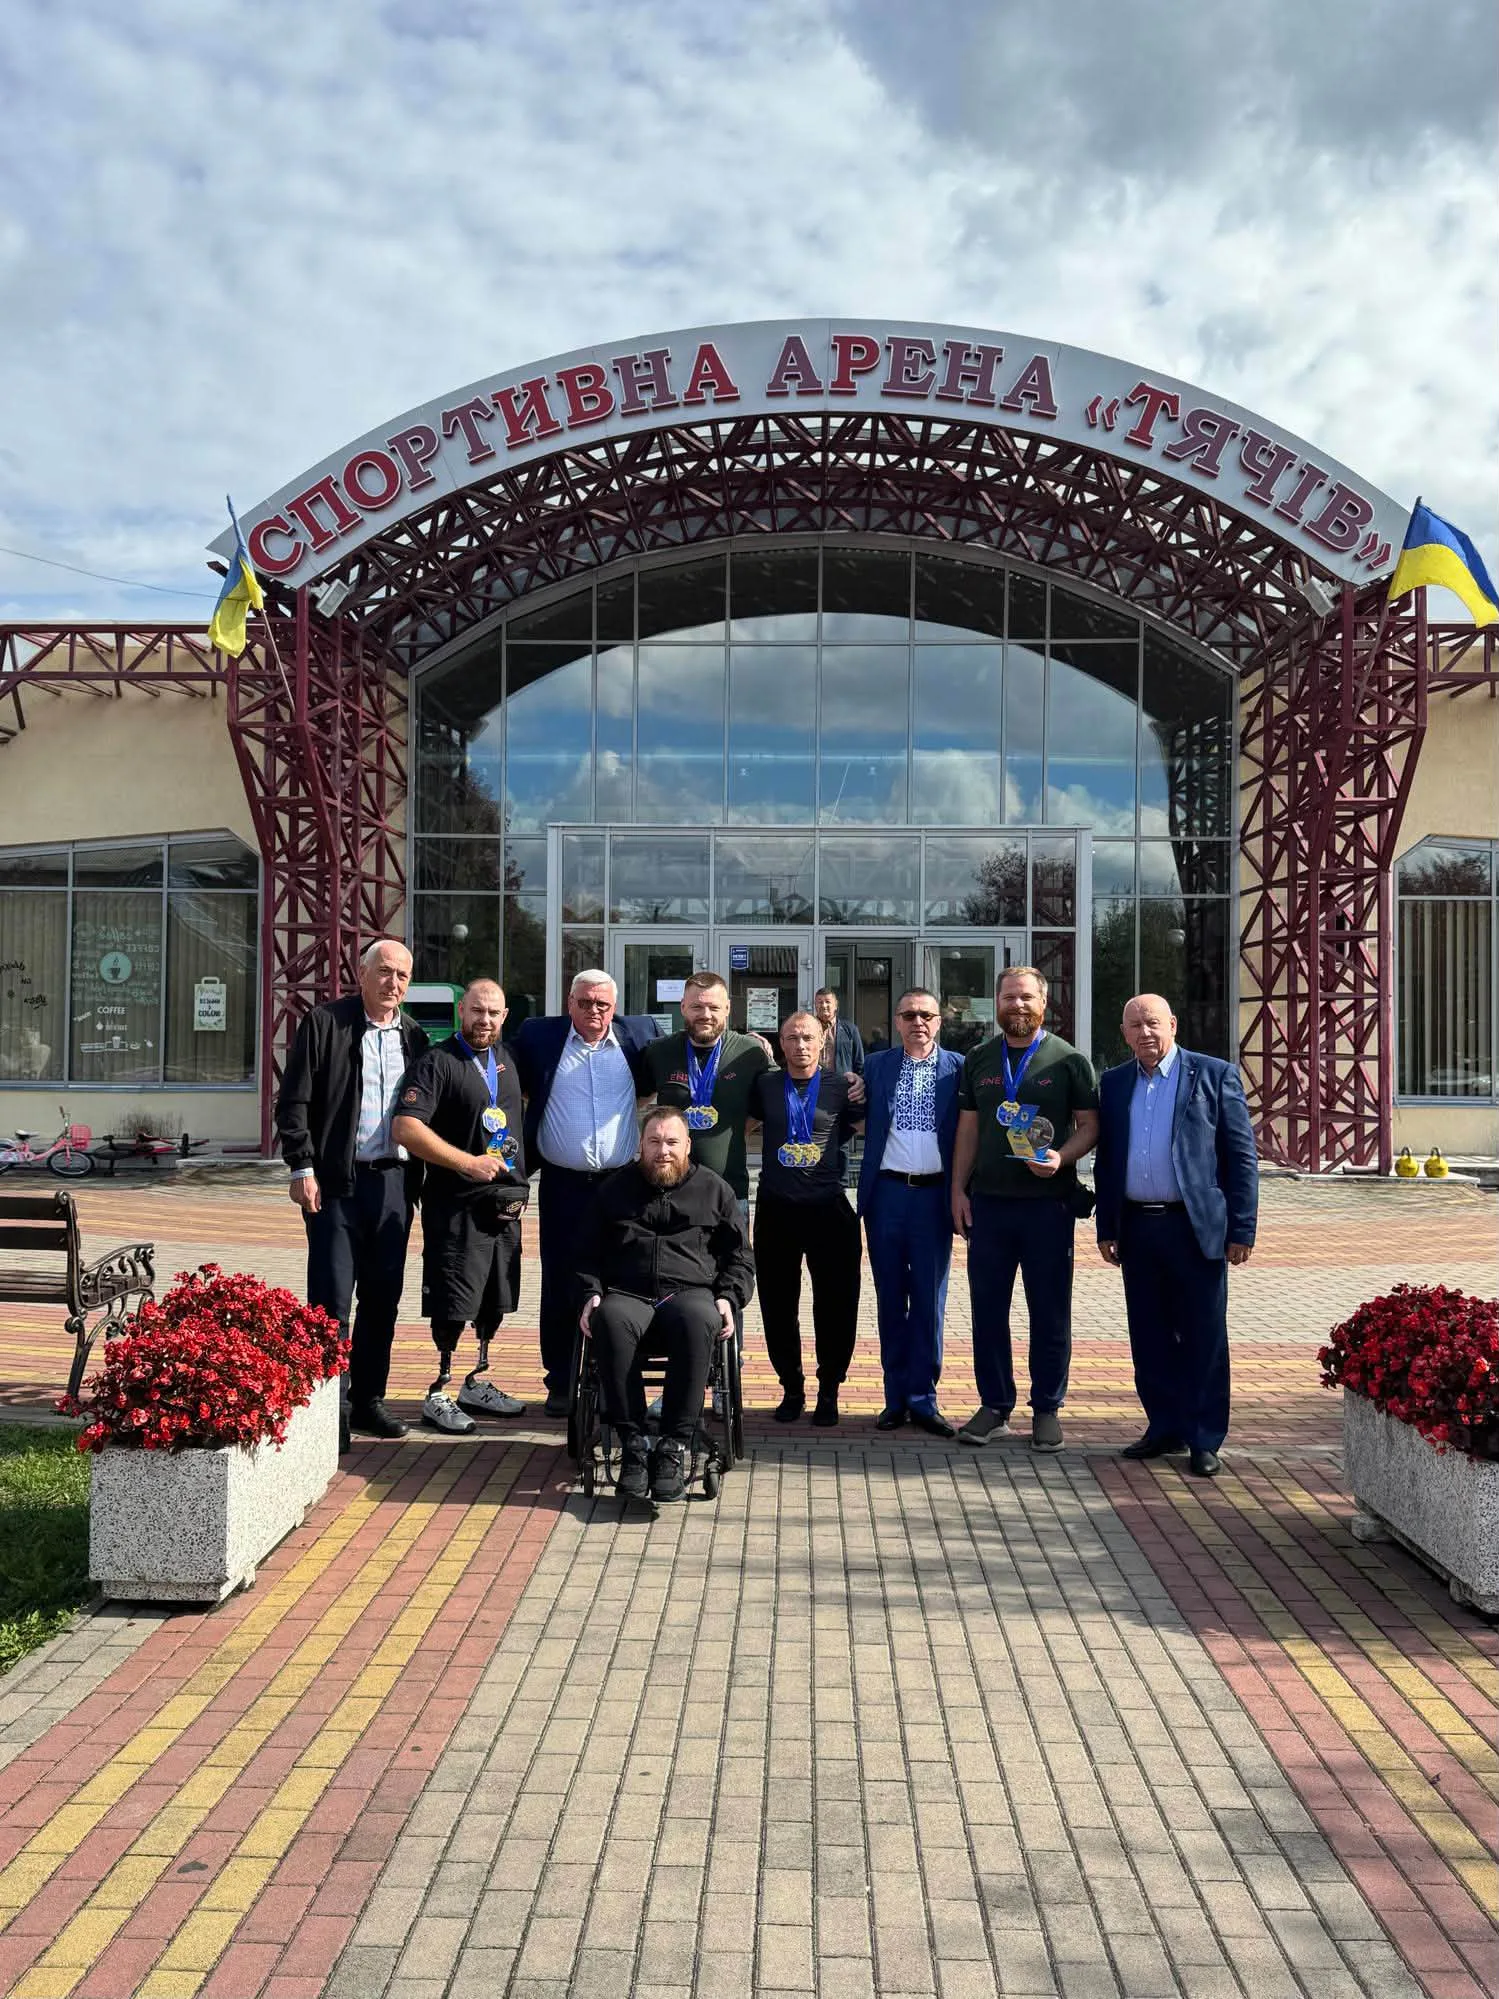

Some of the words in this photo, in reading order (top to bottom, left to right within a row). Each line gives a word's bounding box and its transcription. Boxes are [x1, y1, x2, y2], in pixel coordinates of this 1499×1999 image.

[246, 342, 740, 575] СПОРТИВНА
[766, 334, 1059, 418] АРЕНА
[1085, 380, 1393, 571] «ТЯЧІВ»
[97, 1006, 126, 1015] COFFEE
[480, 1394, 493, 1404] N
[434, 1406, 445, 1417] N
